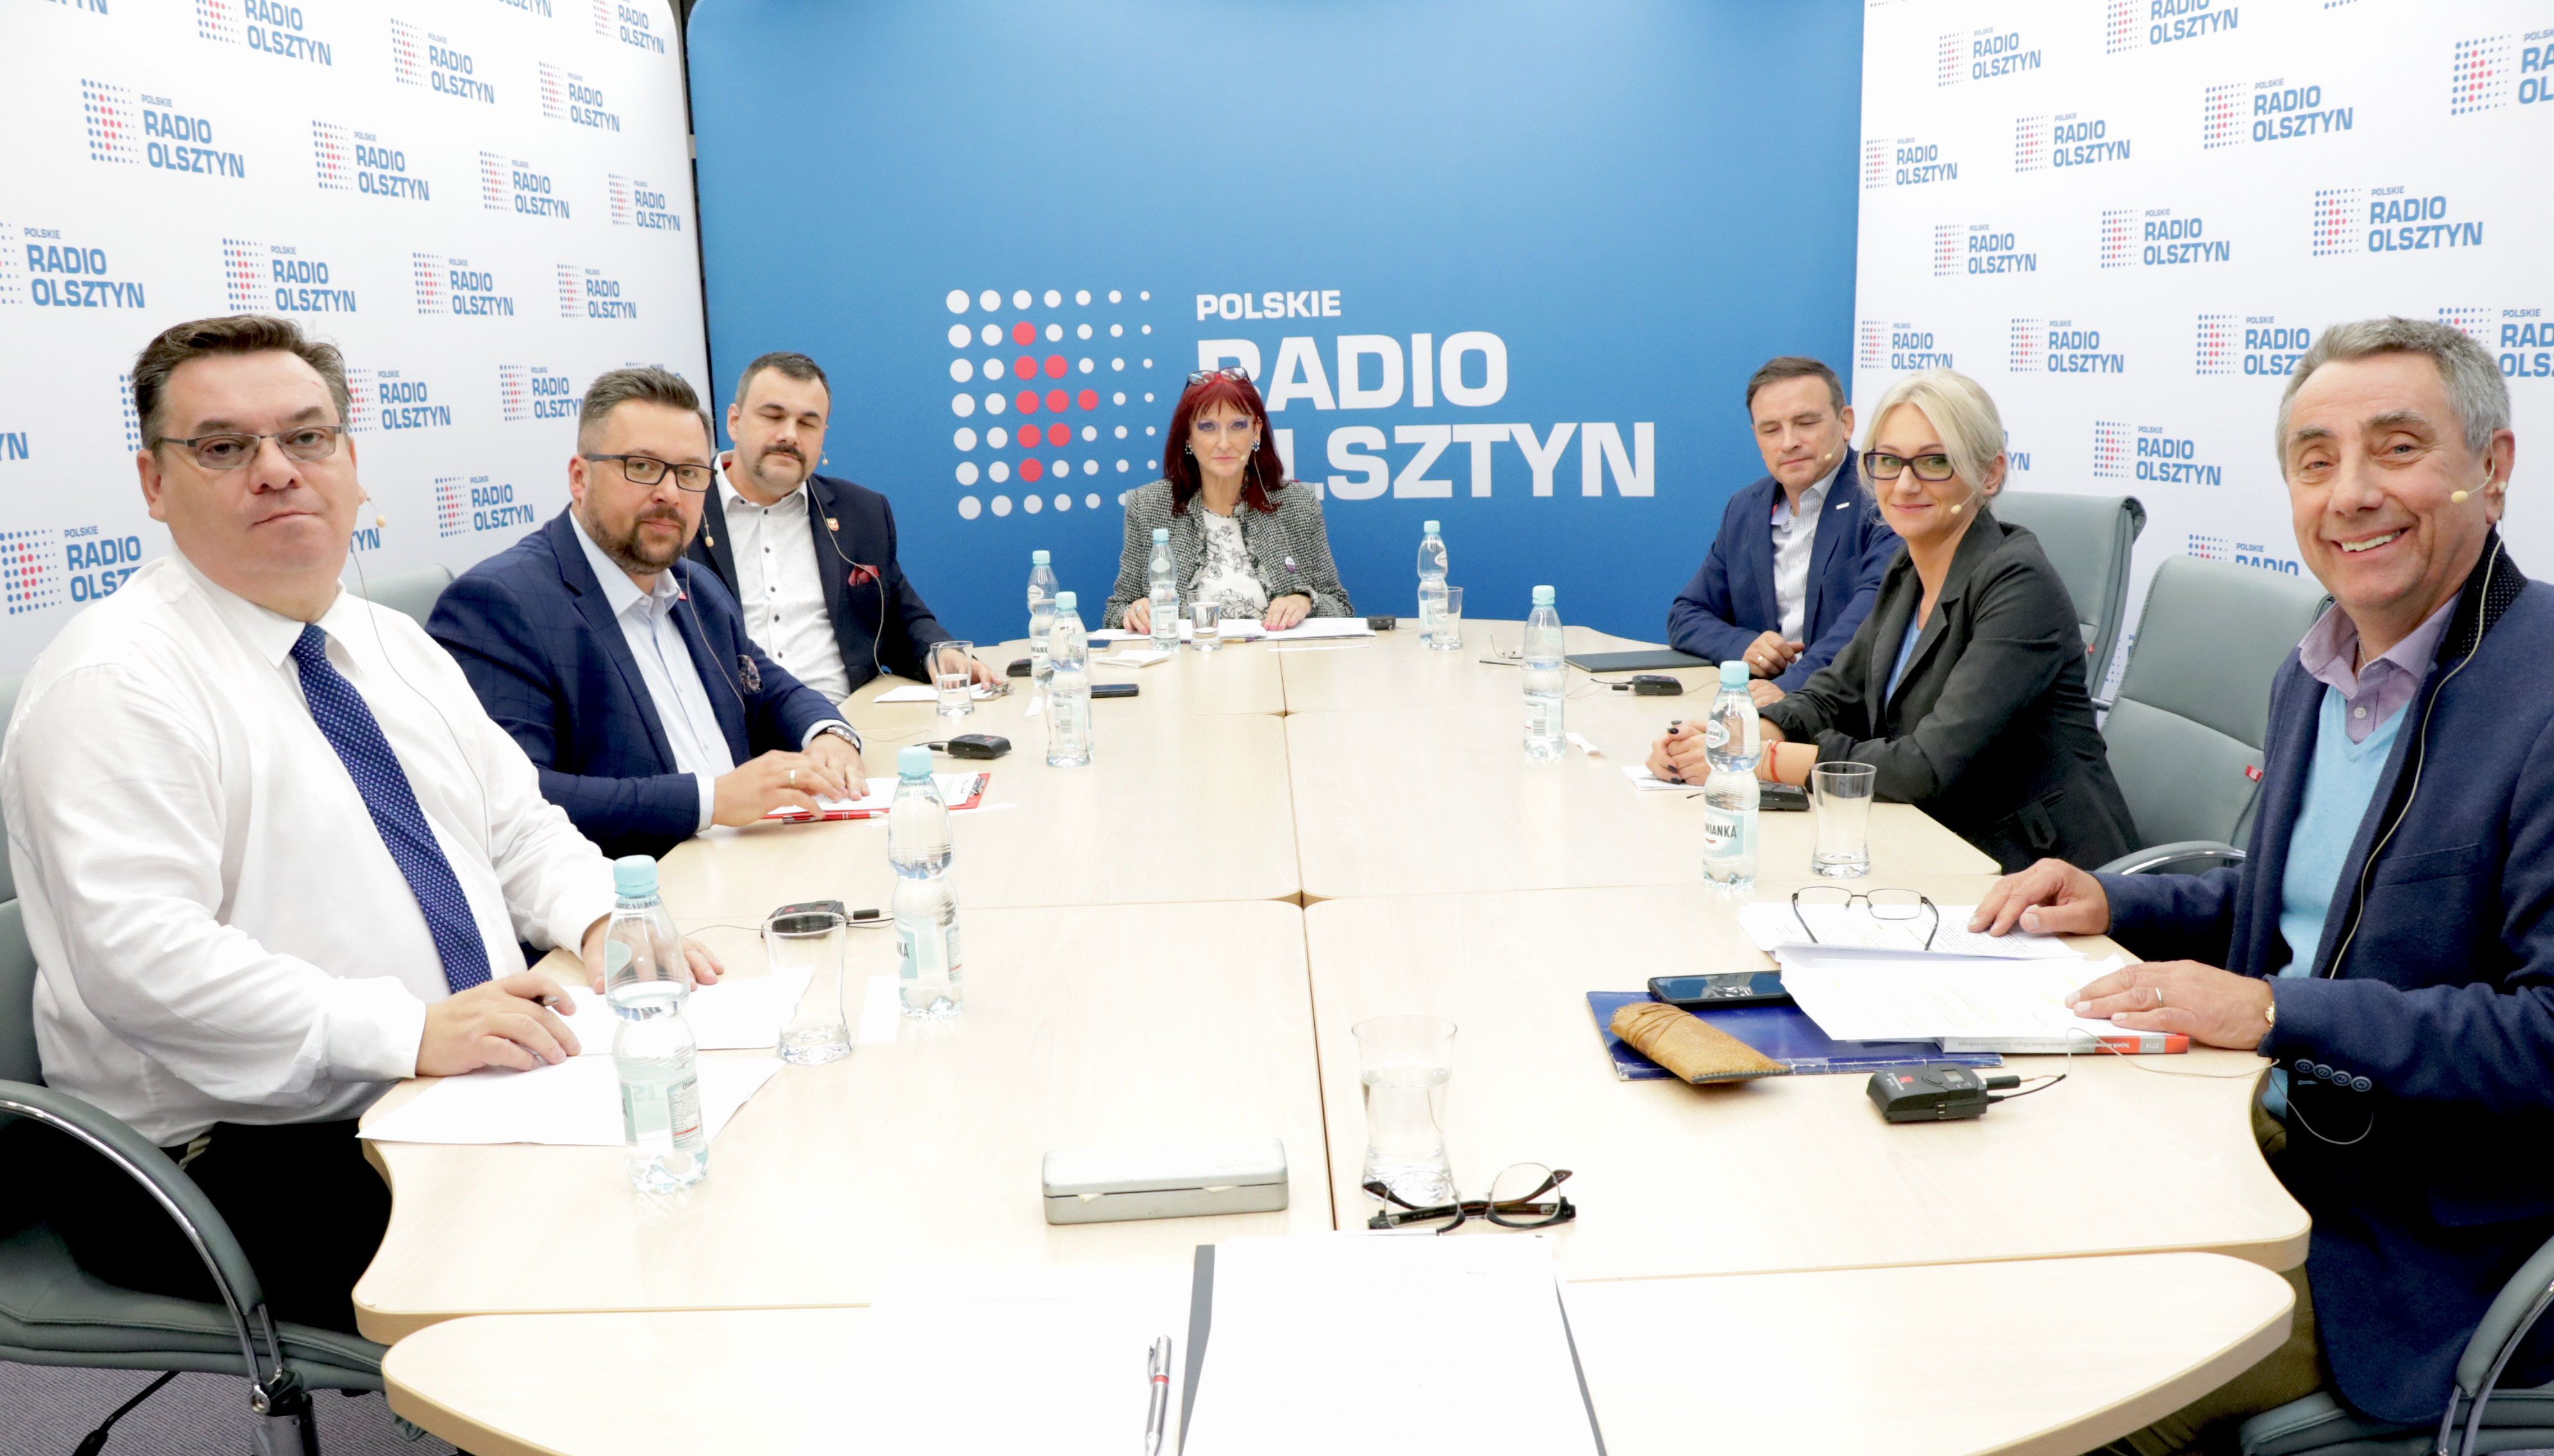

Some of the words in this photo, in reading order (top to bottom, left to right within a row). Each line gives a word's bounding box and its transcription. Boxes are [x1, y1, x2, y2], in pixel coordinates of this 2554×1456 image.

[244, 0, 303, 31] RADIO
[618, 4, 649, 29] RADIO
[2149, 7, 2239, 45] OLSZTYN
[247, 26, 332, 66] OLSZTYN
[620, 26, 664, 54] OLSZTYN
[1973, 32, 2019, 58] RADIO
[429, 46, 473, 75] RADIO
[1973, 49, 2041, 80] OLSZTYN
[431, 71, 494, 104] OLSZTYN
[569, 83, 603, 108] RADIO
[2255, 78, 2284, 90] POLSKIE
[141, 94, 173, 108] POLSKIE
[2253, 85, 2321, 116] RADIO
[143, 110, 212, 144] RADIO
[571, 105, 620, 132] OLSZTYN
[2252, 107, 2353, 142] OLSZTYN
[2054, 120, 2106, 145] RADIO
[147, 143, 245, 178] OLSZTYN
[356, 144, 405, 172] RADIO
[1896, 144, 1938, 165] RADIO
[2053, 139, 2130, 168] OLSZTYN
[358, 171, 429, 201] OLSZTYN
[513, 171, 551, 194] RADIO
[1896, 163, 1957, 186] OLSZTYN
[635, 190, 665, 210] RADIO
[2371, 186, 2405, 196] POLSKIE
[515, 194, 570, 219] OLSZTYN
[2370, 196, 2446, 224] RADIO
[637, 211, 681, 231] OLSZTYN
[2144, 218, 2202, 241] RADIO
[24, 228, 61, 240] POLSKIE
[1969, 233, 2014, 253] RADIO
[2368, 222, 2483, 252] OLSZTYN
[26, 244, 106, 275] RADIO
[271, 245, 296, 255] POLSKIE
[2144, 241, 2230, 265] OLSZTYN
[272, 260, 328, 284] RADIO
[1968, 253, 2036, 274] OLSZTYN
[450, 270, 492, 292] RADIO
[586, 280, 620, 297] RADIO
[31, 279, 145, 308] OLSZTYN
[276, 288, 356, 312] OLSZTYN
[452, 295, 514, 316] OLSZTYN
[1197, 290, 1341, 320] POLSKIE
[588, 301, 637, 318] OLSZTYN
[2503, 309, 2541, 318] POLSKIE
[1892, 333, 1933, 349] RADIO
[2049, 331, 2099, 349] RADIO
[2245, 328, 2310, 349] RADIO
[2501, 323, 2554, 347] RAD
[1892, 353, 1953, 369] OLSZTYN
[2048, 354, 2124, 373] OLSZTYN
[2244, 354, 2305, 375] OLSZ
[379, 382, 428, 404] RADIO
[532, 377, 569, 396] RADIO
[381, 406, 451, 429] OLSZTYN
[2137, 438, 2194, 459] RADIO
[1273, 422, 1654, 500] LSZTYN
[2136, 461, 2221, 486] OLSZTYN
[471, 484, 513, 508] RADIO
[474, 504, 534, 531] OLSZTYN
[65, 526, 98, 538] POLSKIE
[66, 536, 141, 570] RADIO
[2236, 543, 2264, 552] POLSKIE
[71, 566, 142, 602] OLSZ
